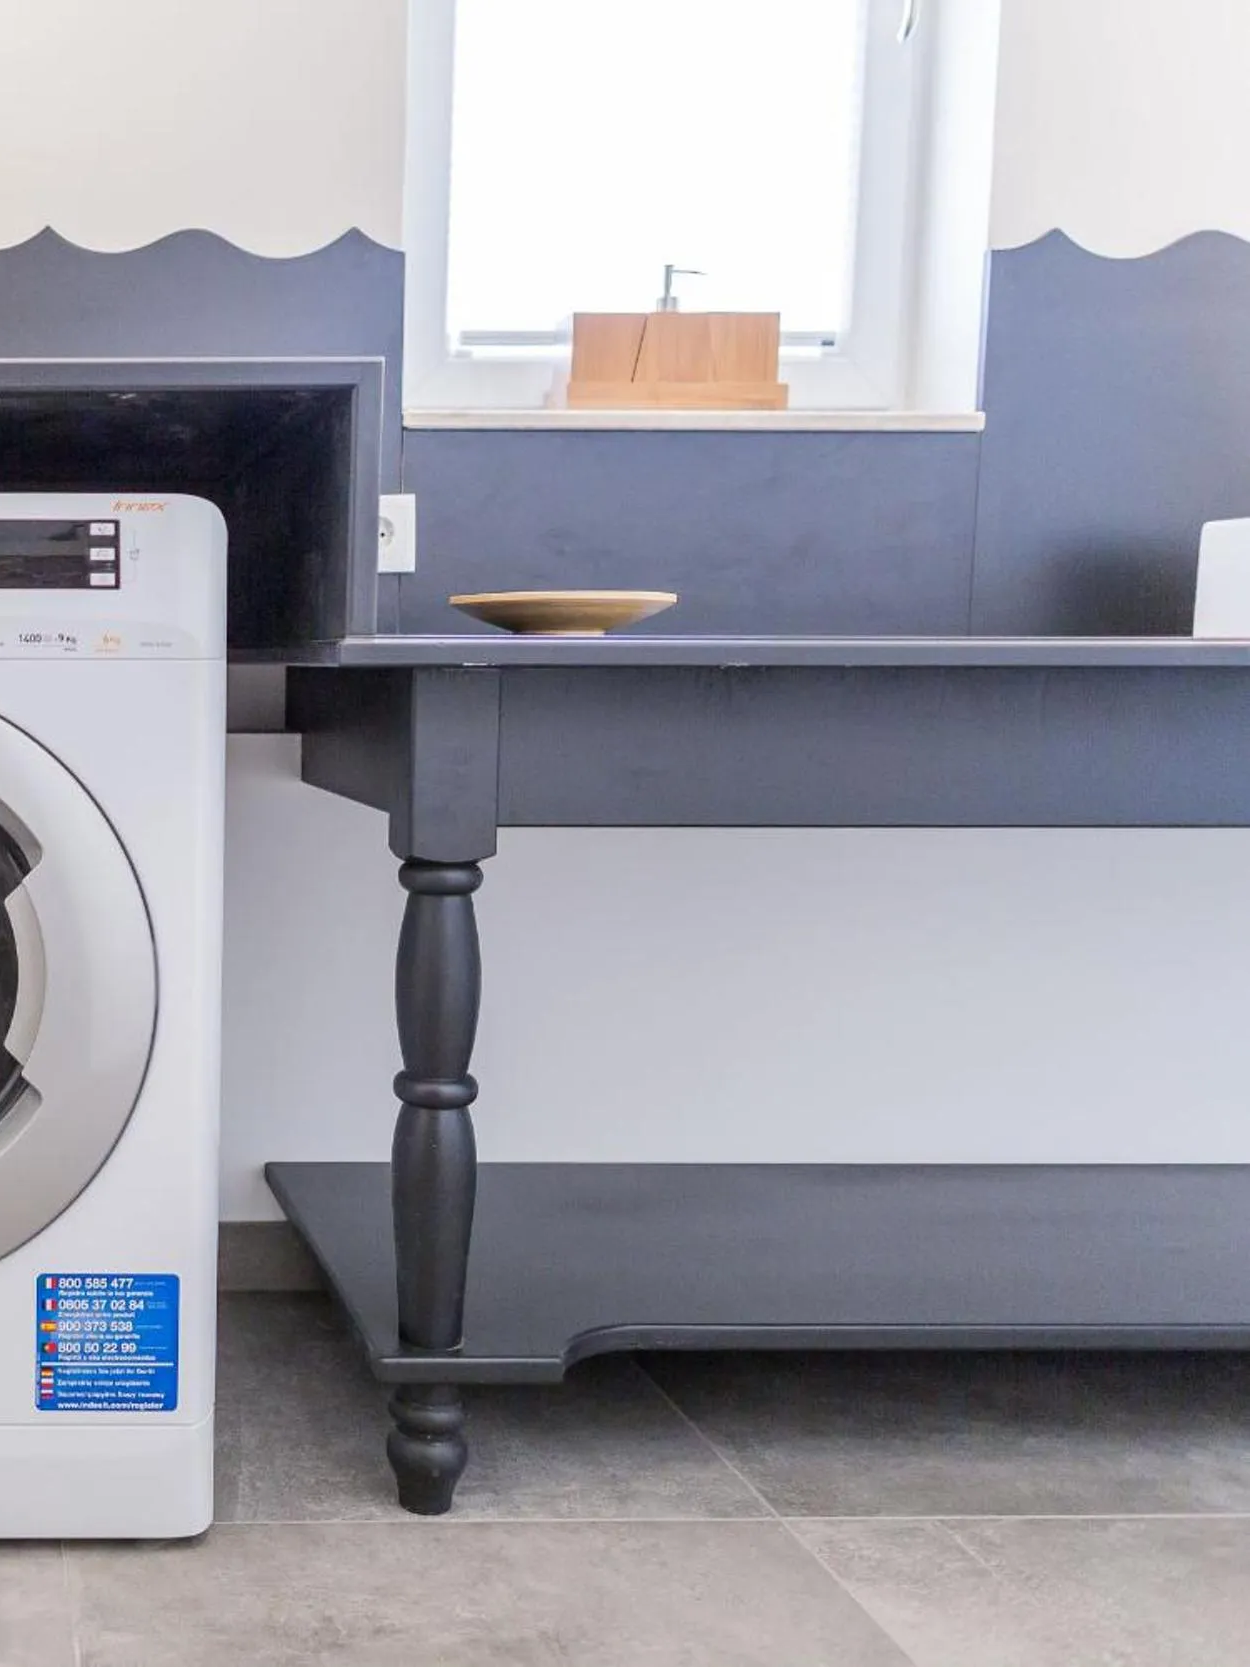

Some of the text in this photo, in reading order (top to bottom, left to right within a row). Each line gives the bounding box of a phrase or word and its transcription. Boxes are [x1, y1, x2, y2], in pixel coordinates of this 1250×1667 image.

[19, 633, 42, 643] 1400
[58, 1278, 82, 1289] 800
[110, 1278, 134, 1289] 477
[92, 1299, 107, 1310] 37
[110, 1299, 125, 1310] 02
[129, 1299, 144, 1310] 84
[58, 1321, 81, 1332] 900
[84, 1321, 107, 1332] 373
[110, 1321, 133, 1332] 538
[58, 1342, 81, 1353] 800
[102, 1342, 118, 1353] 22
[121, 1342, 137, 1353] 99
